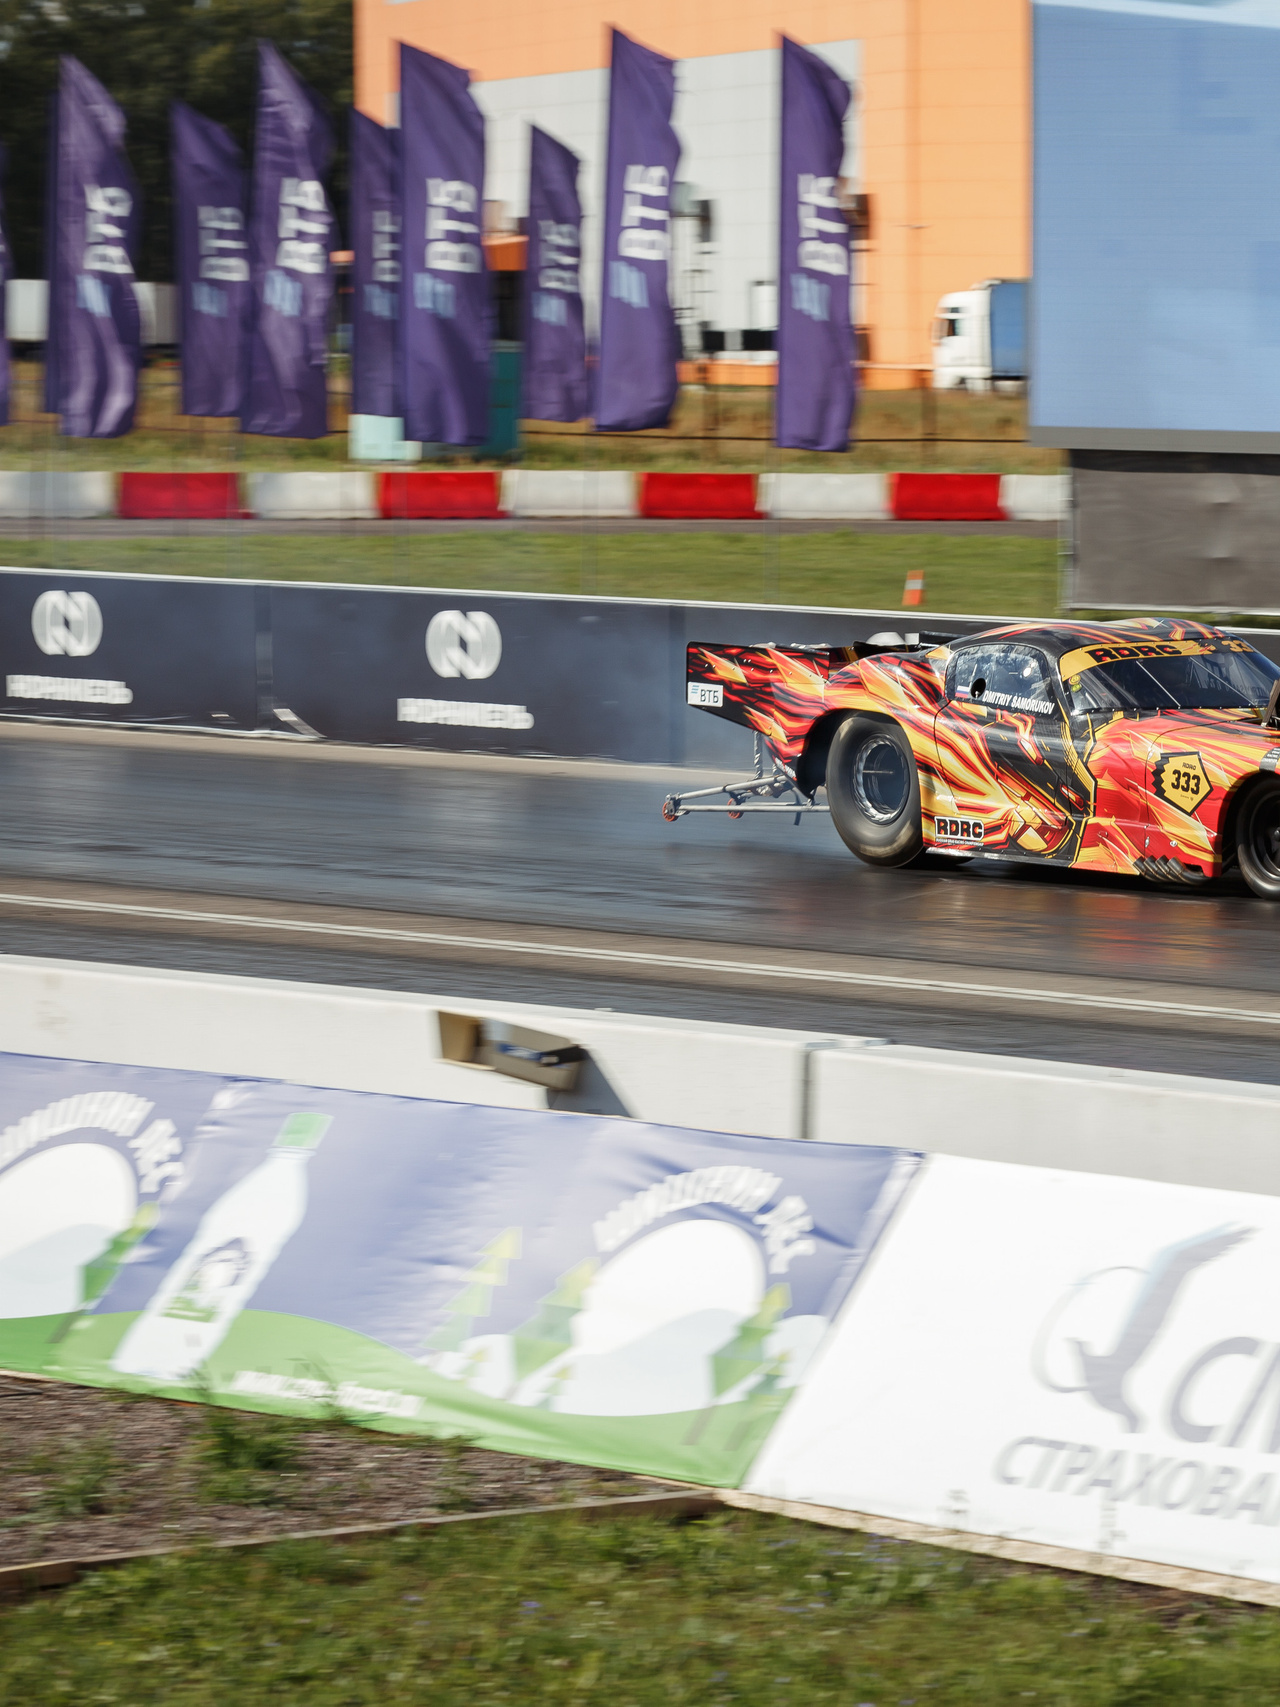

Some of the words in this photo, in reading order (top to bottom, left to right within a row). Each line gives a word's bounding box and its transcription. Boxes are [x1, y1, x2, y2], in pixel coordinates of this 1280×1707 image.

[1085, 644, 1183, 664] RDRC
[700, 689, 719, 703] ВТБ
[982, 690, 1013, 706] DMITRIY
[1011, 695, 1055, 715] SAMORUKOV
[1171, 769, 1201, 795] 333
[936, 818, 983, 839] RDRC
